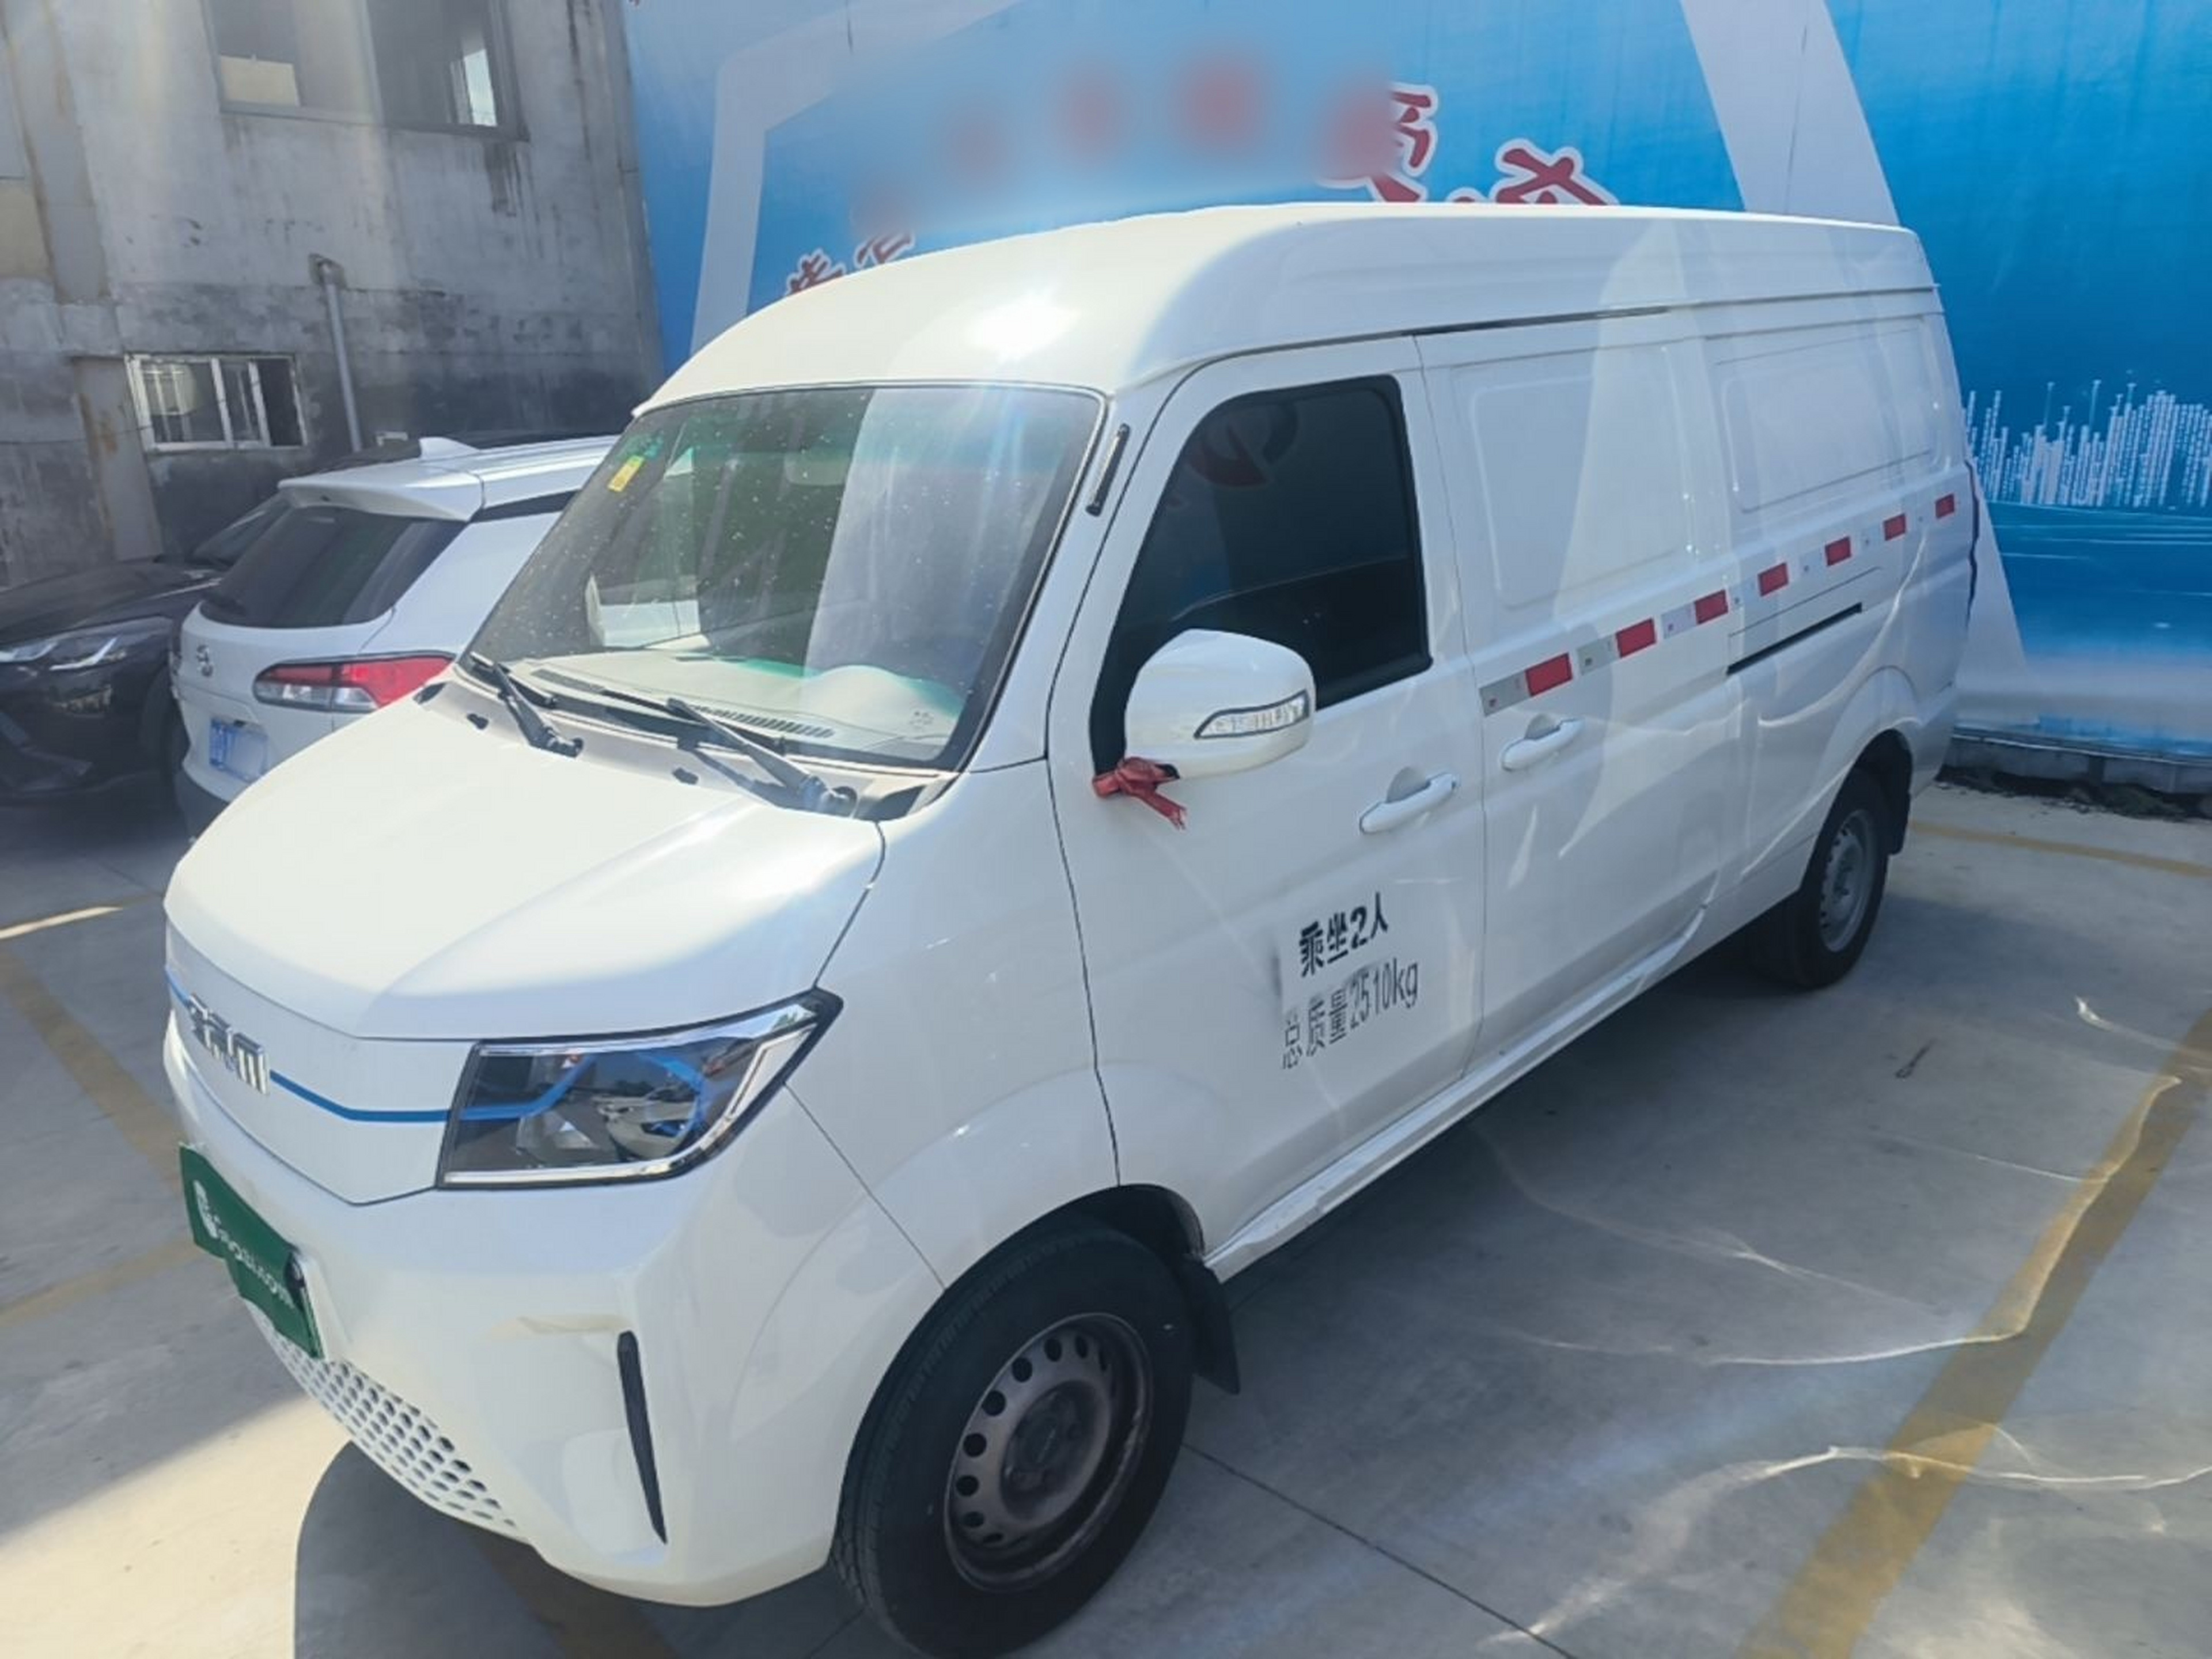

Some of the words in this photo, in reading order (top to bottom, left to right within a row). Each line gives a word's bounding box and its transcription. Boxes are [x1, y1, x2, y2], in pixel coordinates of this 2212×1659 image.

[1299, 891, 1388, 978] 乘坐2人
[1282, 957, 1419, 1070] 总质量2510kg
